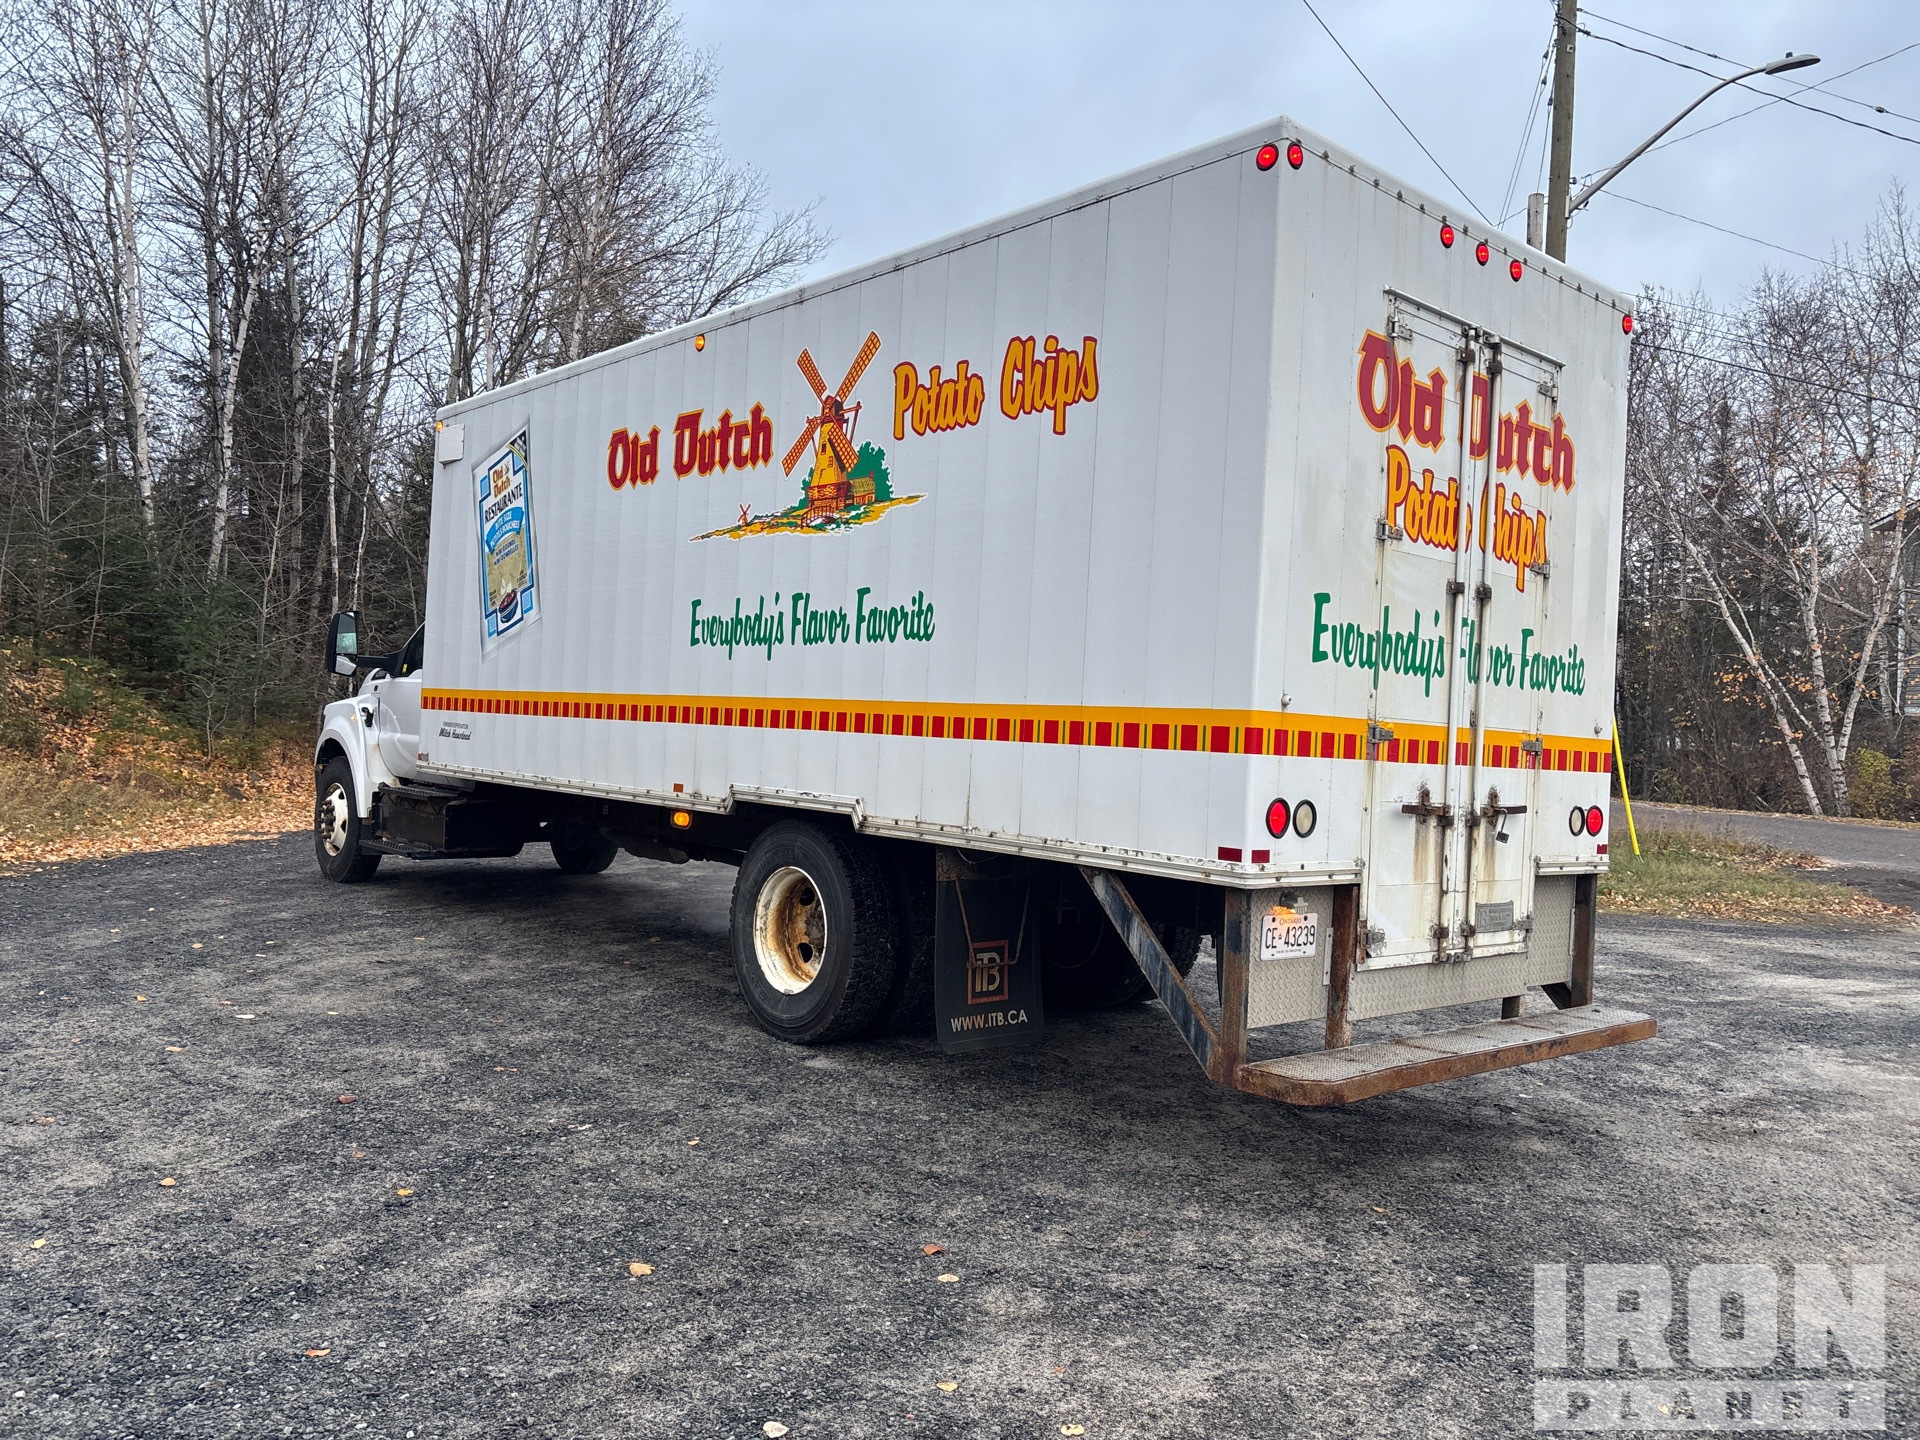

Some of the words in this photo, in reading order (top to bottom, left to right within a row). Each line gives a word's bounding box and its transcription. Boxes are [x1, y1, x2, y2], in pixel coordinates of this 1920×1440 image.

[893, 360, 985, 441] Potato
[1000, 335, 1098, 435] Chips
[1357, 329, 1448, 453] Old
[608, 425, 660, 490] Old
[673, 401, 773, 480] Dutch
[492, 466, 503, 484] Old
[493, 476, 511, 498] Dutch
[690, 591, 785, 661] Everybody's
[791, 592, 850, 645] Flavor
[856, 587, 935, 645] Favorite
[1311, 592, 1445, 697] Everybody's
[1520, 628, 1585, 696] Favorite
[1265, 927, 1278, 949] CE
[1284, 925, 1316, 948] 43239
[1279, 918, 1302, 926] ONTARIO
[950, 1009, 1028, 1033] WWW.ITB.CA
